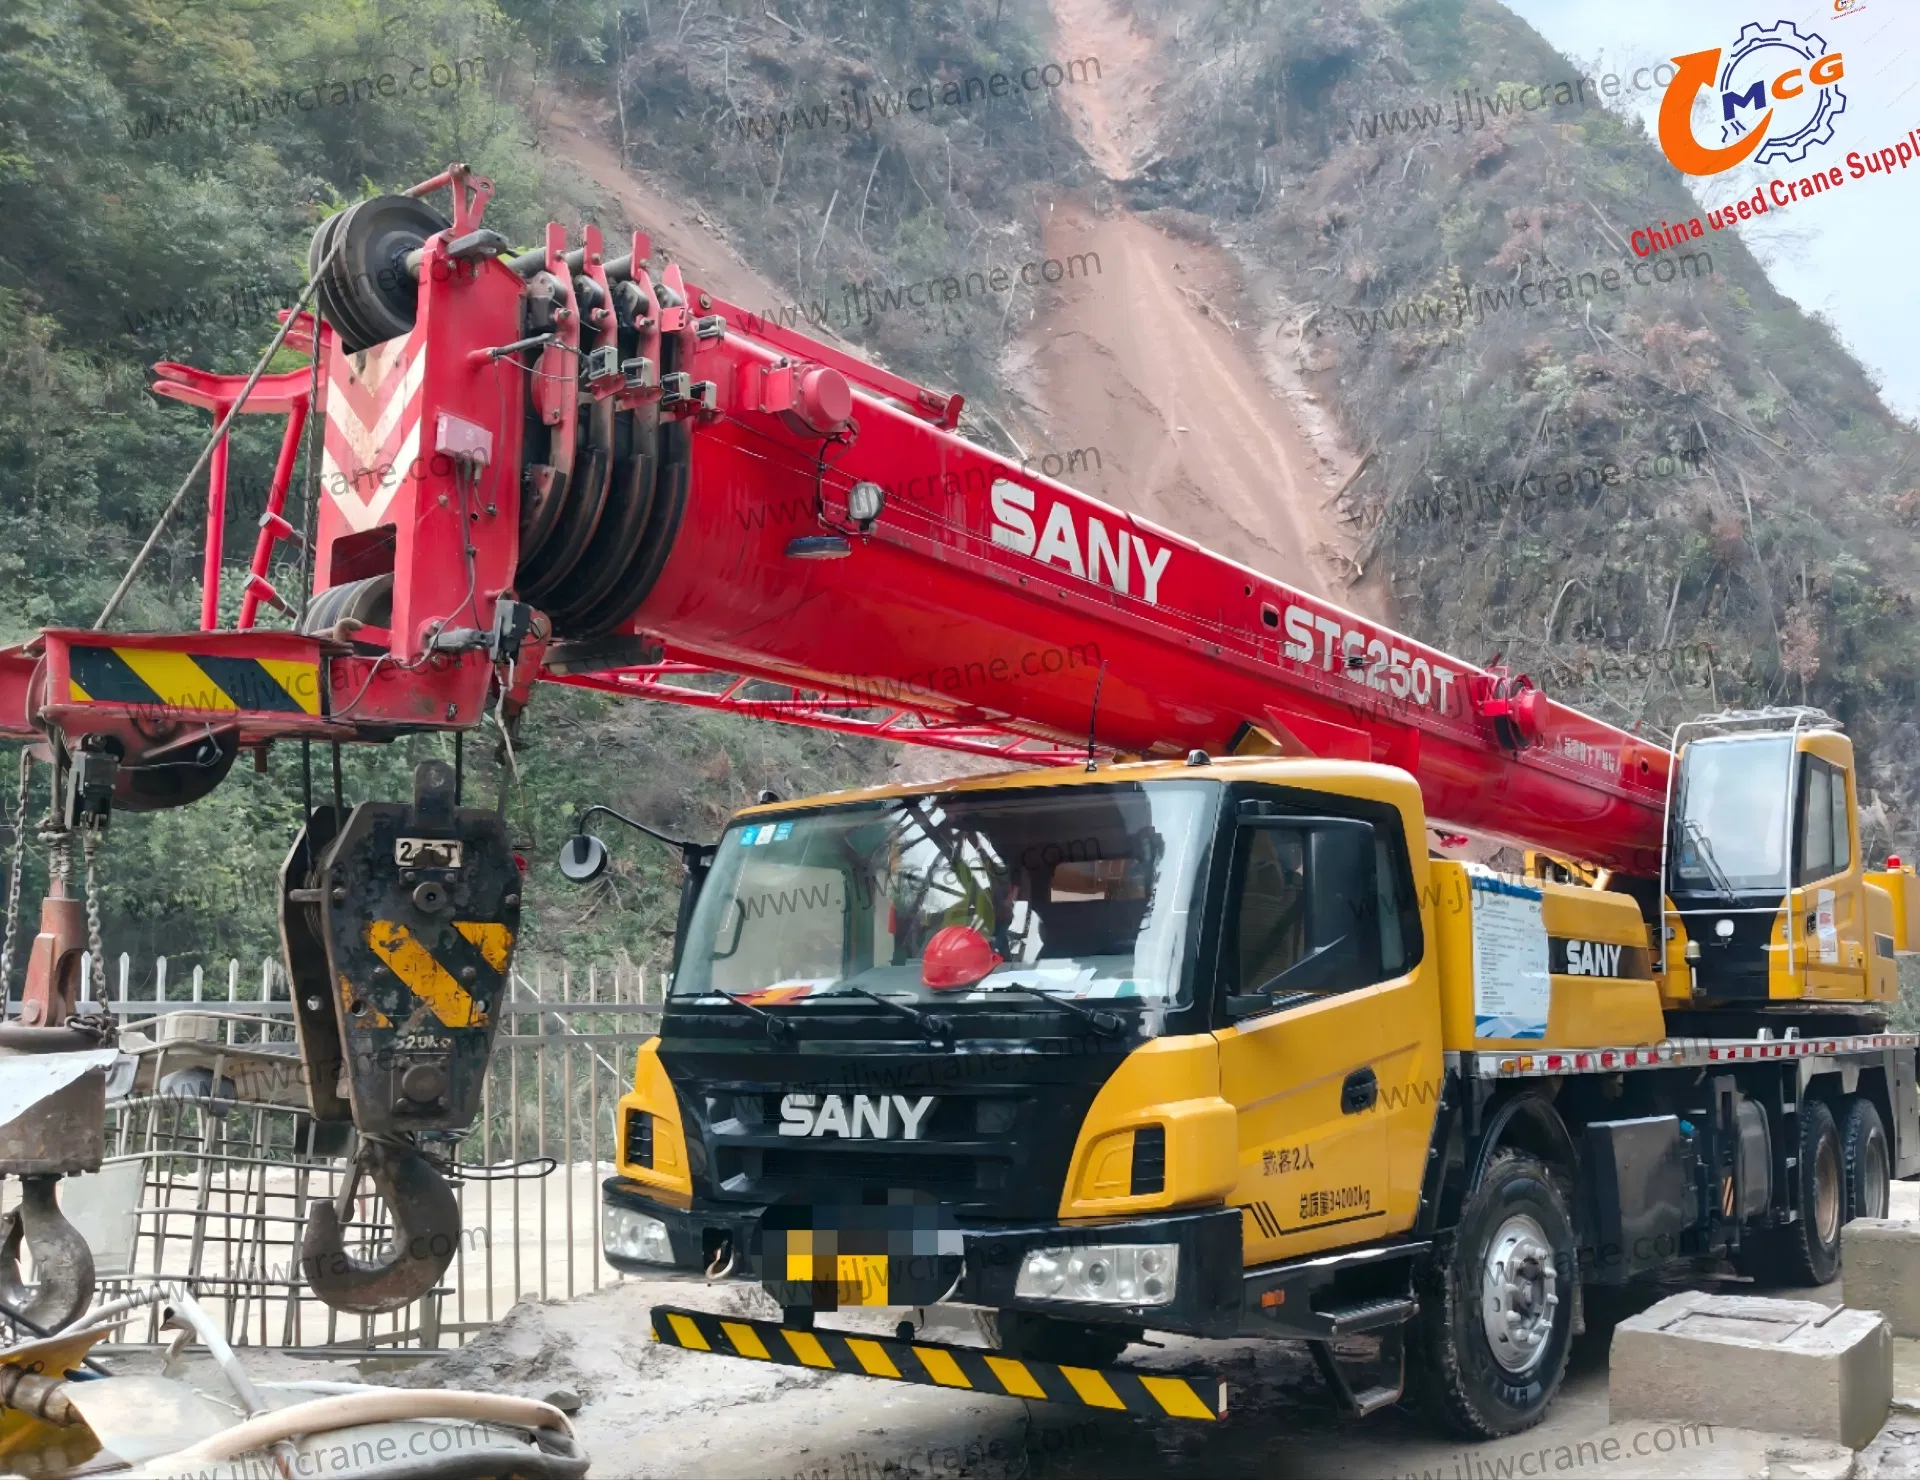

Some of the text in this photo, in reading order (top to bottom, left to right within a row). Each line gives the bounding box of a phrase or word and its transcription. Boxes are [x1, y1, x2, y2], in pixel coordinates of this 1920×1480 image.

[991, 478, 1172, 606] SANY
[1285, 605, 1454, 714] STC250T
[1566, 940, 1621, 976] SANY
[778, 1094, 934, 1139] SANY
